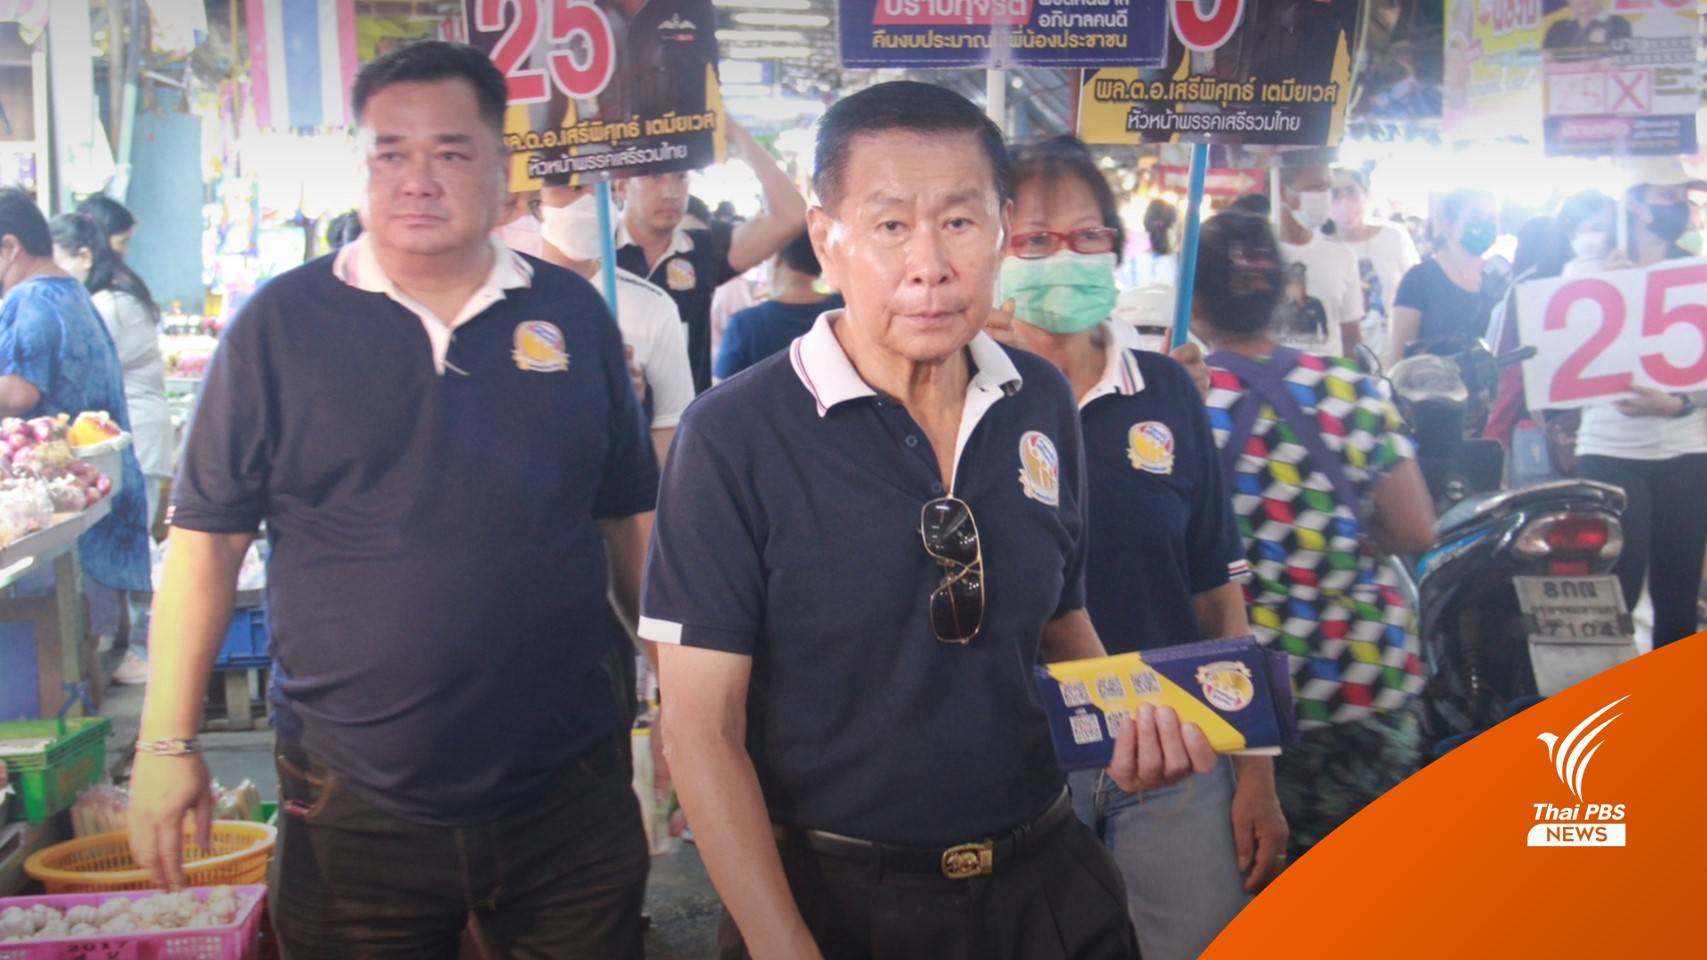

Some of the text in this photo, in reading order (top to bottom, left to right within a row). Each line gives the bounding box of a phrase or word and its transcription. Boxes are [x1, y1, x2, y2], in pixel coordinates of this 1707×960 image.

[883, 0, 1027, 25] ปราบทุจรต
[1037, 9, 1129, 28] อภิบาลคนดี
[474, 0, 616, 104] 25
[1095, 77, 1338, 108] พล.ต.อ.เสรีพิศุทธ์ เตมียเวส
[504, 115, 641, 151] ล.ต.อ.เสรีพิศุทธ์
[1127, 108, 1301, 132] หัวหน้าพรรคเสรีรวมไทย
[528, 142, 688, 178] หัวหน้าพรรคเสรีรวมไทย
[1543, 263, 1707, 403] 25
